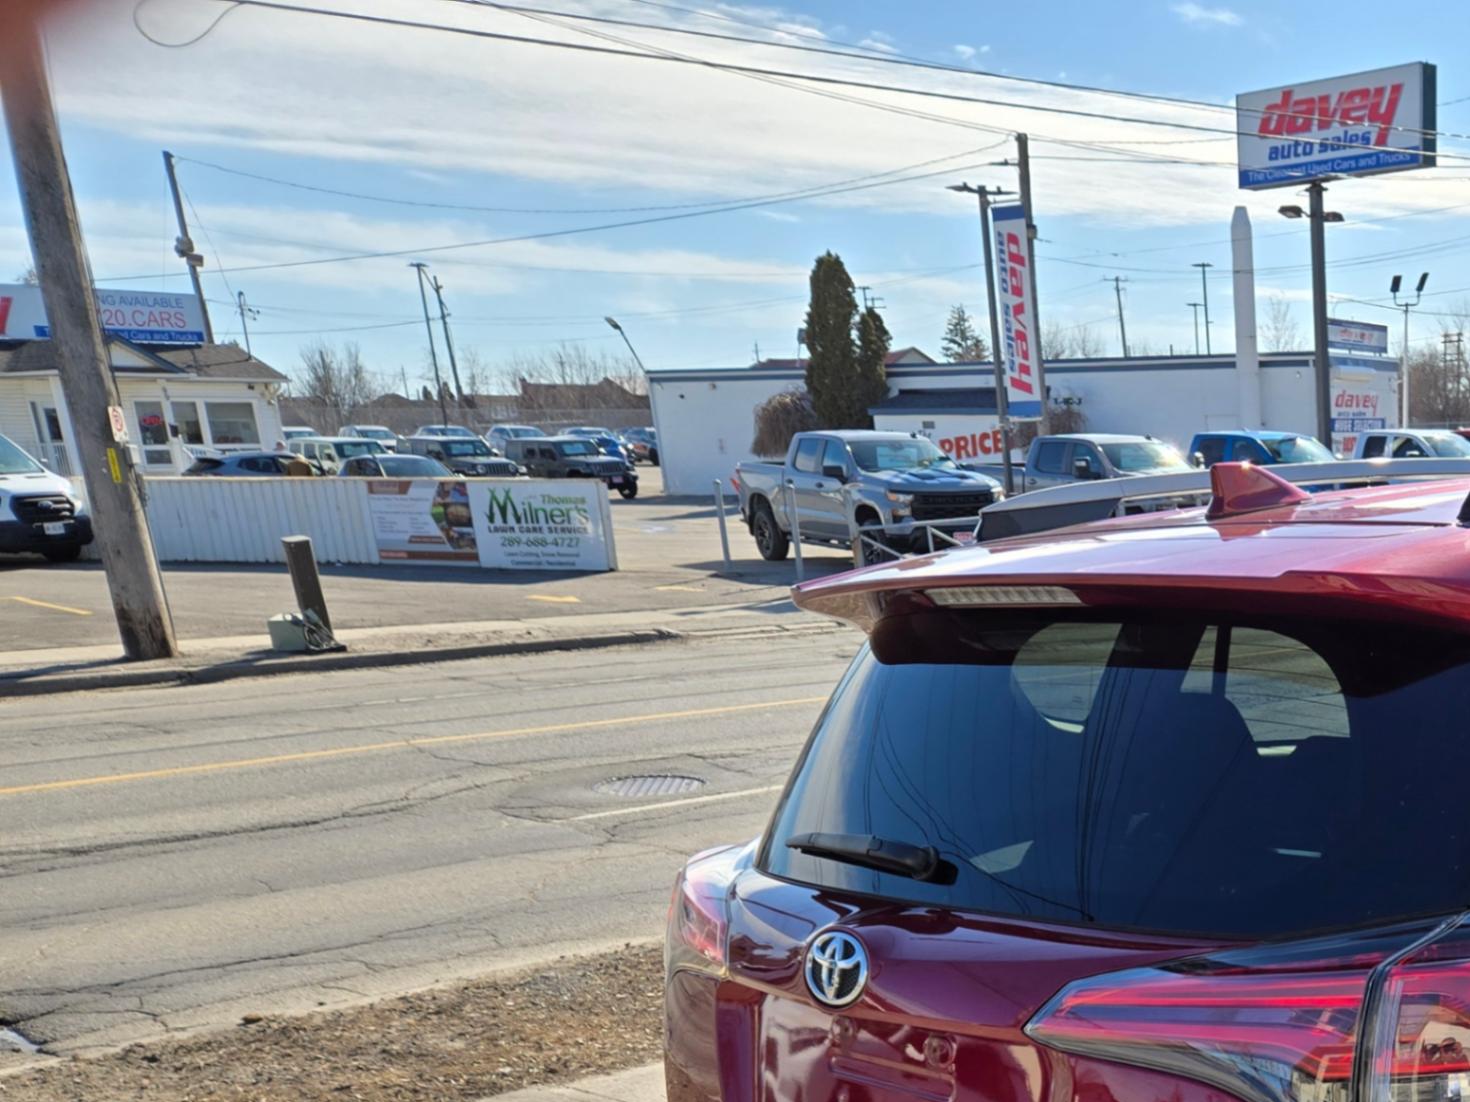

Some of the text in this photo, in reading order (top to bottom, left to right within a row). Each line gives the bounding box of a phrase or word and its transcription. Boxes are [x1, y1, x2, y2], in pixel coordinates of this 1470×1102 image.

[1258, 83, 1404, 147] davey
[1268, 129, 1372, 161] auto sales
[1248, 170, 1266, 182] The
[1307, 160, 1332, 175] Used
[1333, 157, 1356, 172] Cars
[1357, 154, 1377, 167] and
[1379, 150, 1411, 165] Trucks
[997, 231, 1010, 294] auto
[119, 295, 185, 309] AVAILABLE
[1006, 231, 1034, 395] davey
[97, 308, 187, 329] 20.CARS
[1335, 390, 1378, 417] davey
[939, 429, 1003, 460] PRICE
[518, 526, 545, 534] CARE
